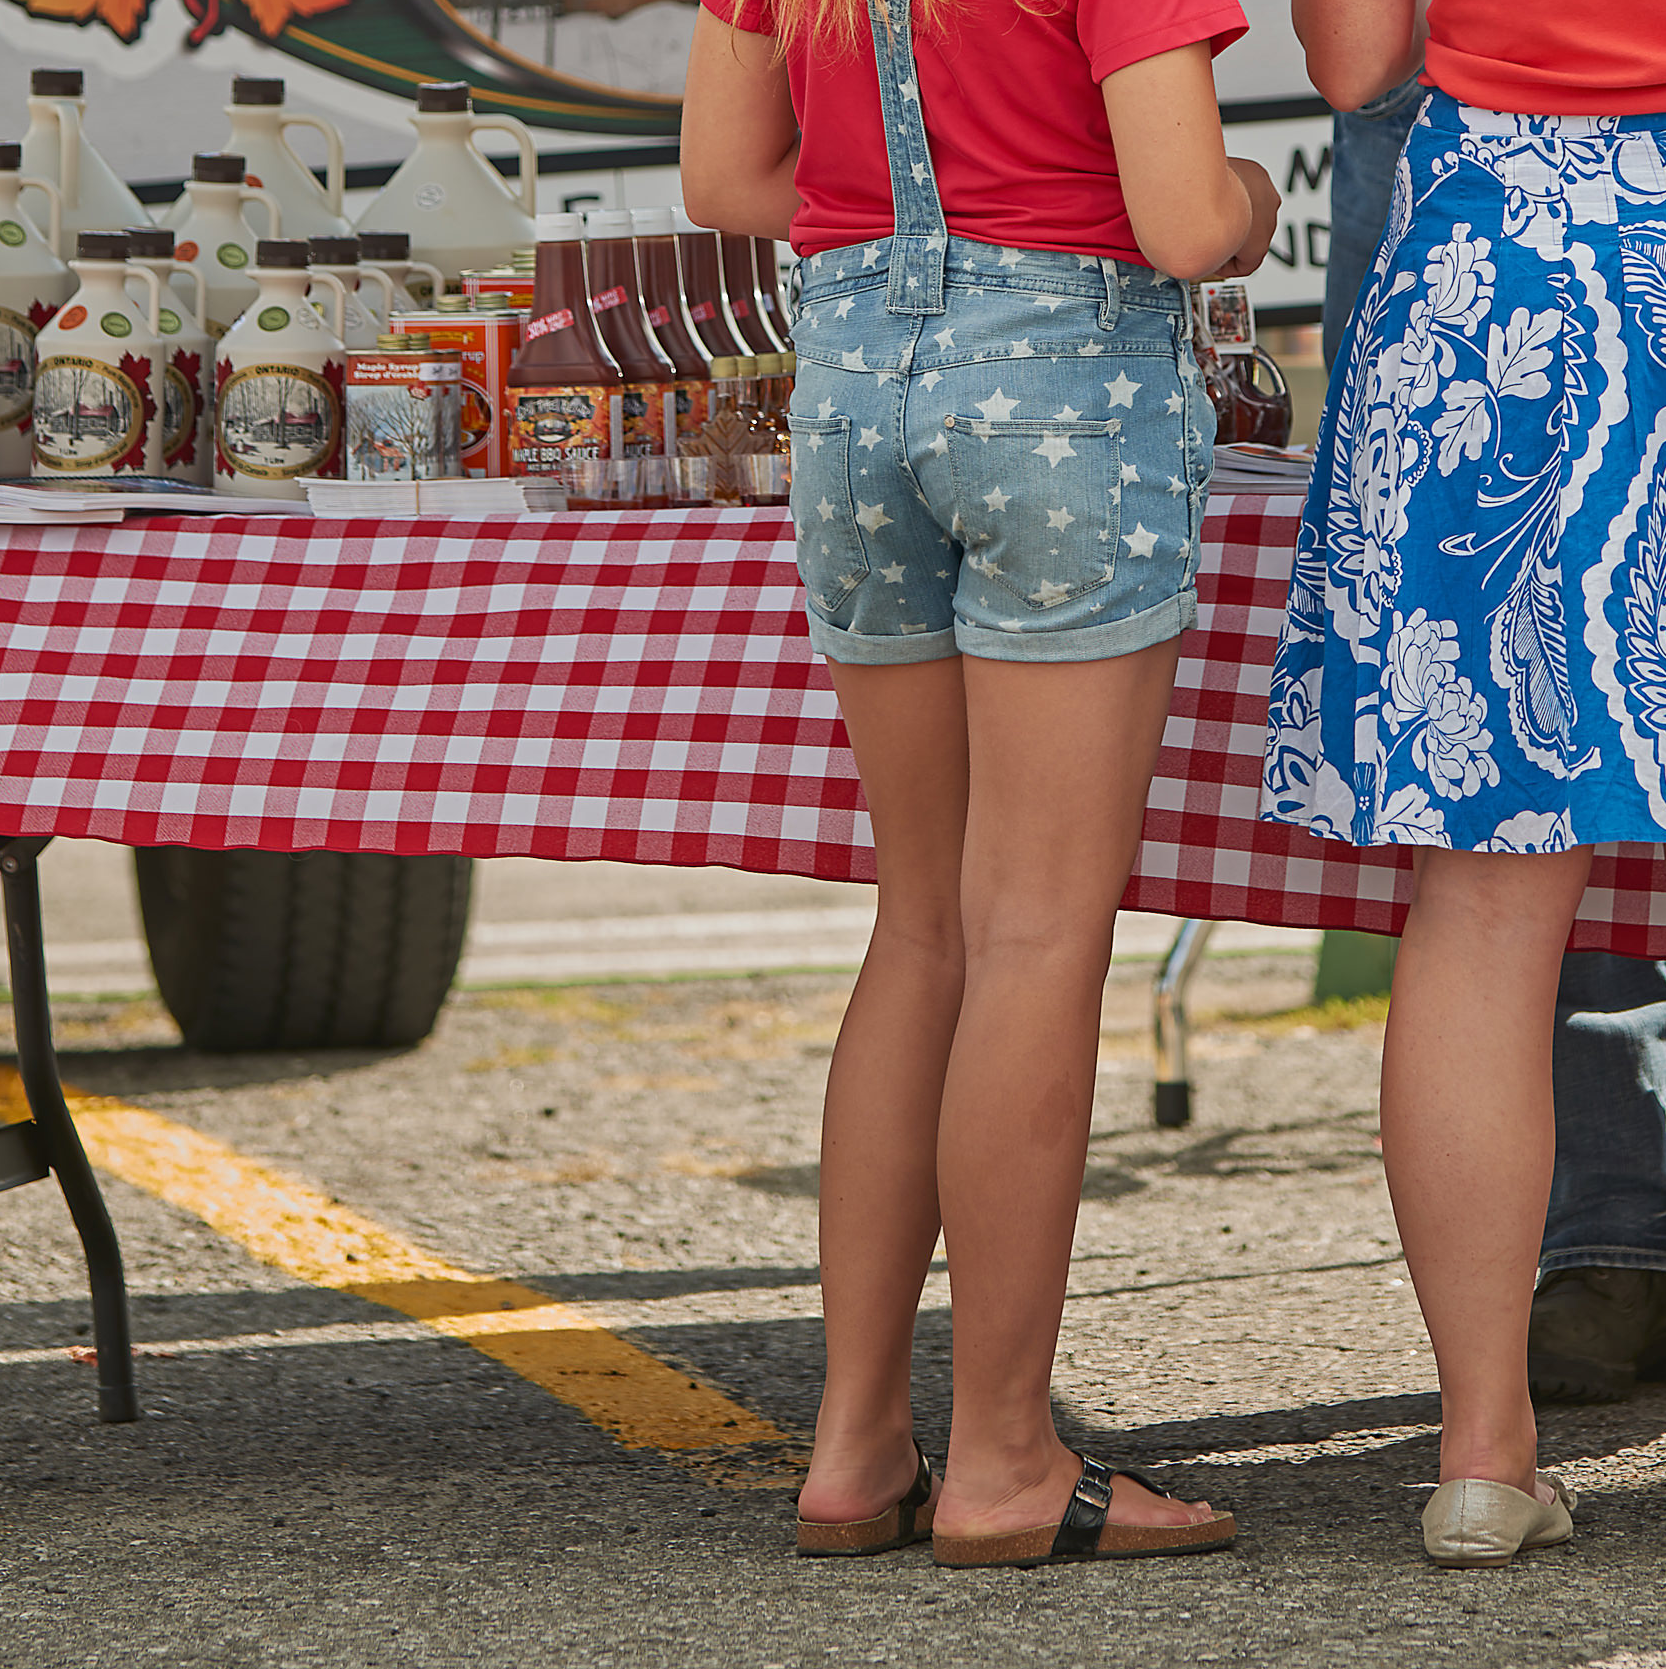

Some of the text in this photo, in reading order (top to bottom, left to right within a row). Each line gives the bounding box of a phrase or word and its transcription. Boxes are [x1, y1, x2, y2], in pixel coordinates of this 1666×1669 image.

[53, 356, 94, 369] ONTARIO
[356, 363, 420, 373] Maple Syrup
[255, 364, 300, 376] ONTARIO
[353, 371, 382, 381] Sirop
[540, 447, 561, 462] BBQ
[564, 446, 600, 461] SAUCE
